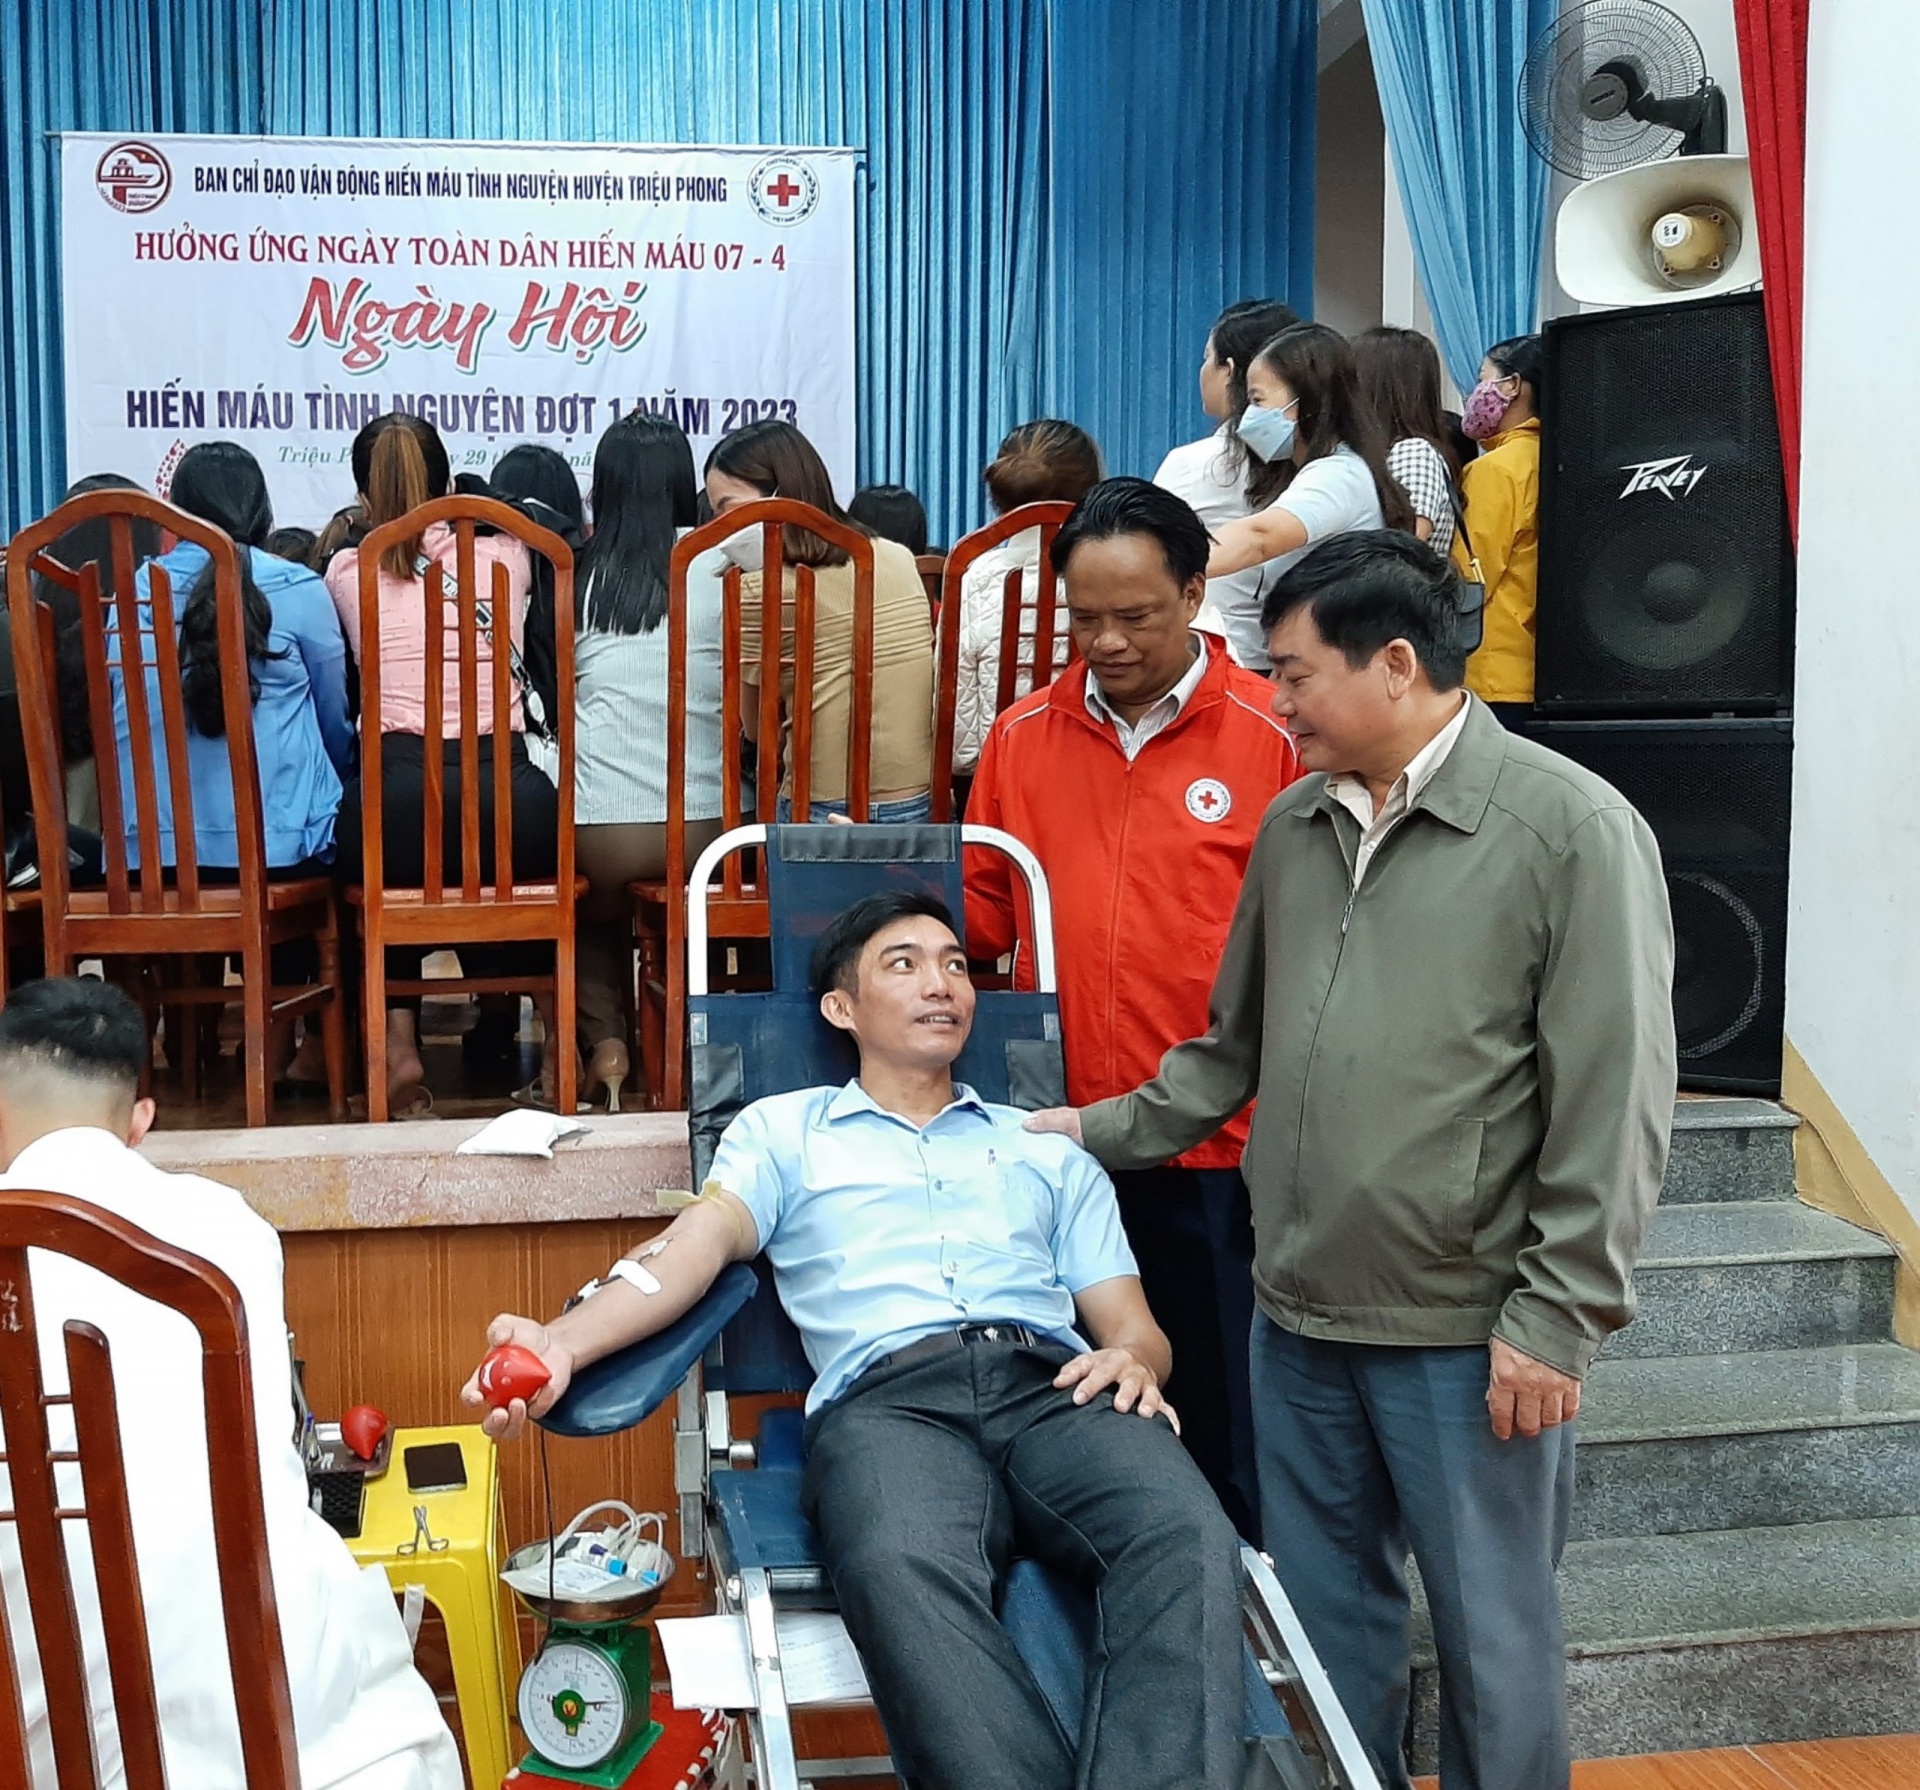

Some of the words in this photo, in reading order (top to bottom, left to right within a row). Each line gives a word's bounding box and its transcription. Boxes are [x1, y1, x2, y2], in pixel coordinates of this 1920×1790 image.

[194, 167, 228, 193] BAN
[233, 158, 259, 193] CHỈ
[264, 168, 295, 199] ĐẠO
[300, 163, 331, 200] VẬN
[337, 165, 380, 201] ĐỘNG
[385, 162, 421, 197] HIẾN
[427, 166, 461, 197] MÁU
[466, 167, 501, 198] TÌNH
[507, 169, 568, 206] NGUYỆN
[574, 170, 623, 206] HUYỆN
[628, 171, 671, 207] TRIỆU
[676, 176, 727, 202] PHONG
[134, 222, 239, 261] HƯỞNG
[249, 226, 308, 263] ỨNG
[317, 228, 400, 264] NGÀY
[408, 230, 490, 266] TOÀN
[499, 232, 558, 268] DÂN
[567, 229, 635, 270] HIẾN
[644, 233, 705, 270] MÁU
[714, 243, 744, 270] 07
[771, 244, 785, 271] 4
[288, 276, 492, 372] Ngày
[509, 280, 645, 361] Hội
[127, 377, 205, 429] HIẾN
[217, 383, 293, 430] MÁU
[304, 384, 381, 431] TÌNH
[536, 393, 596, 443] ĐỢT
[278, 446, 331, 468] Triệu
[463, 449, 487, 466] 29
